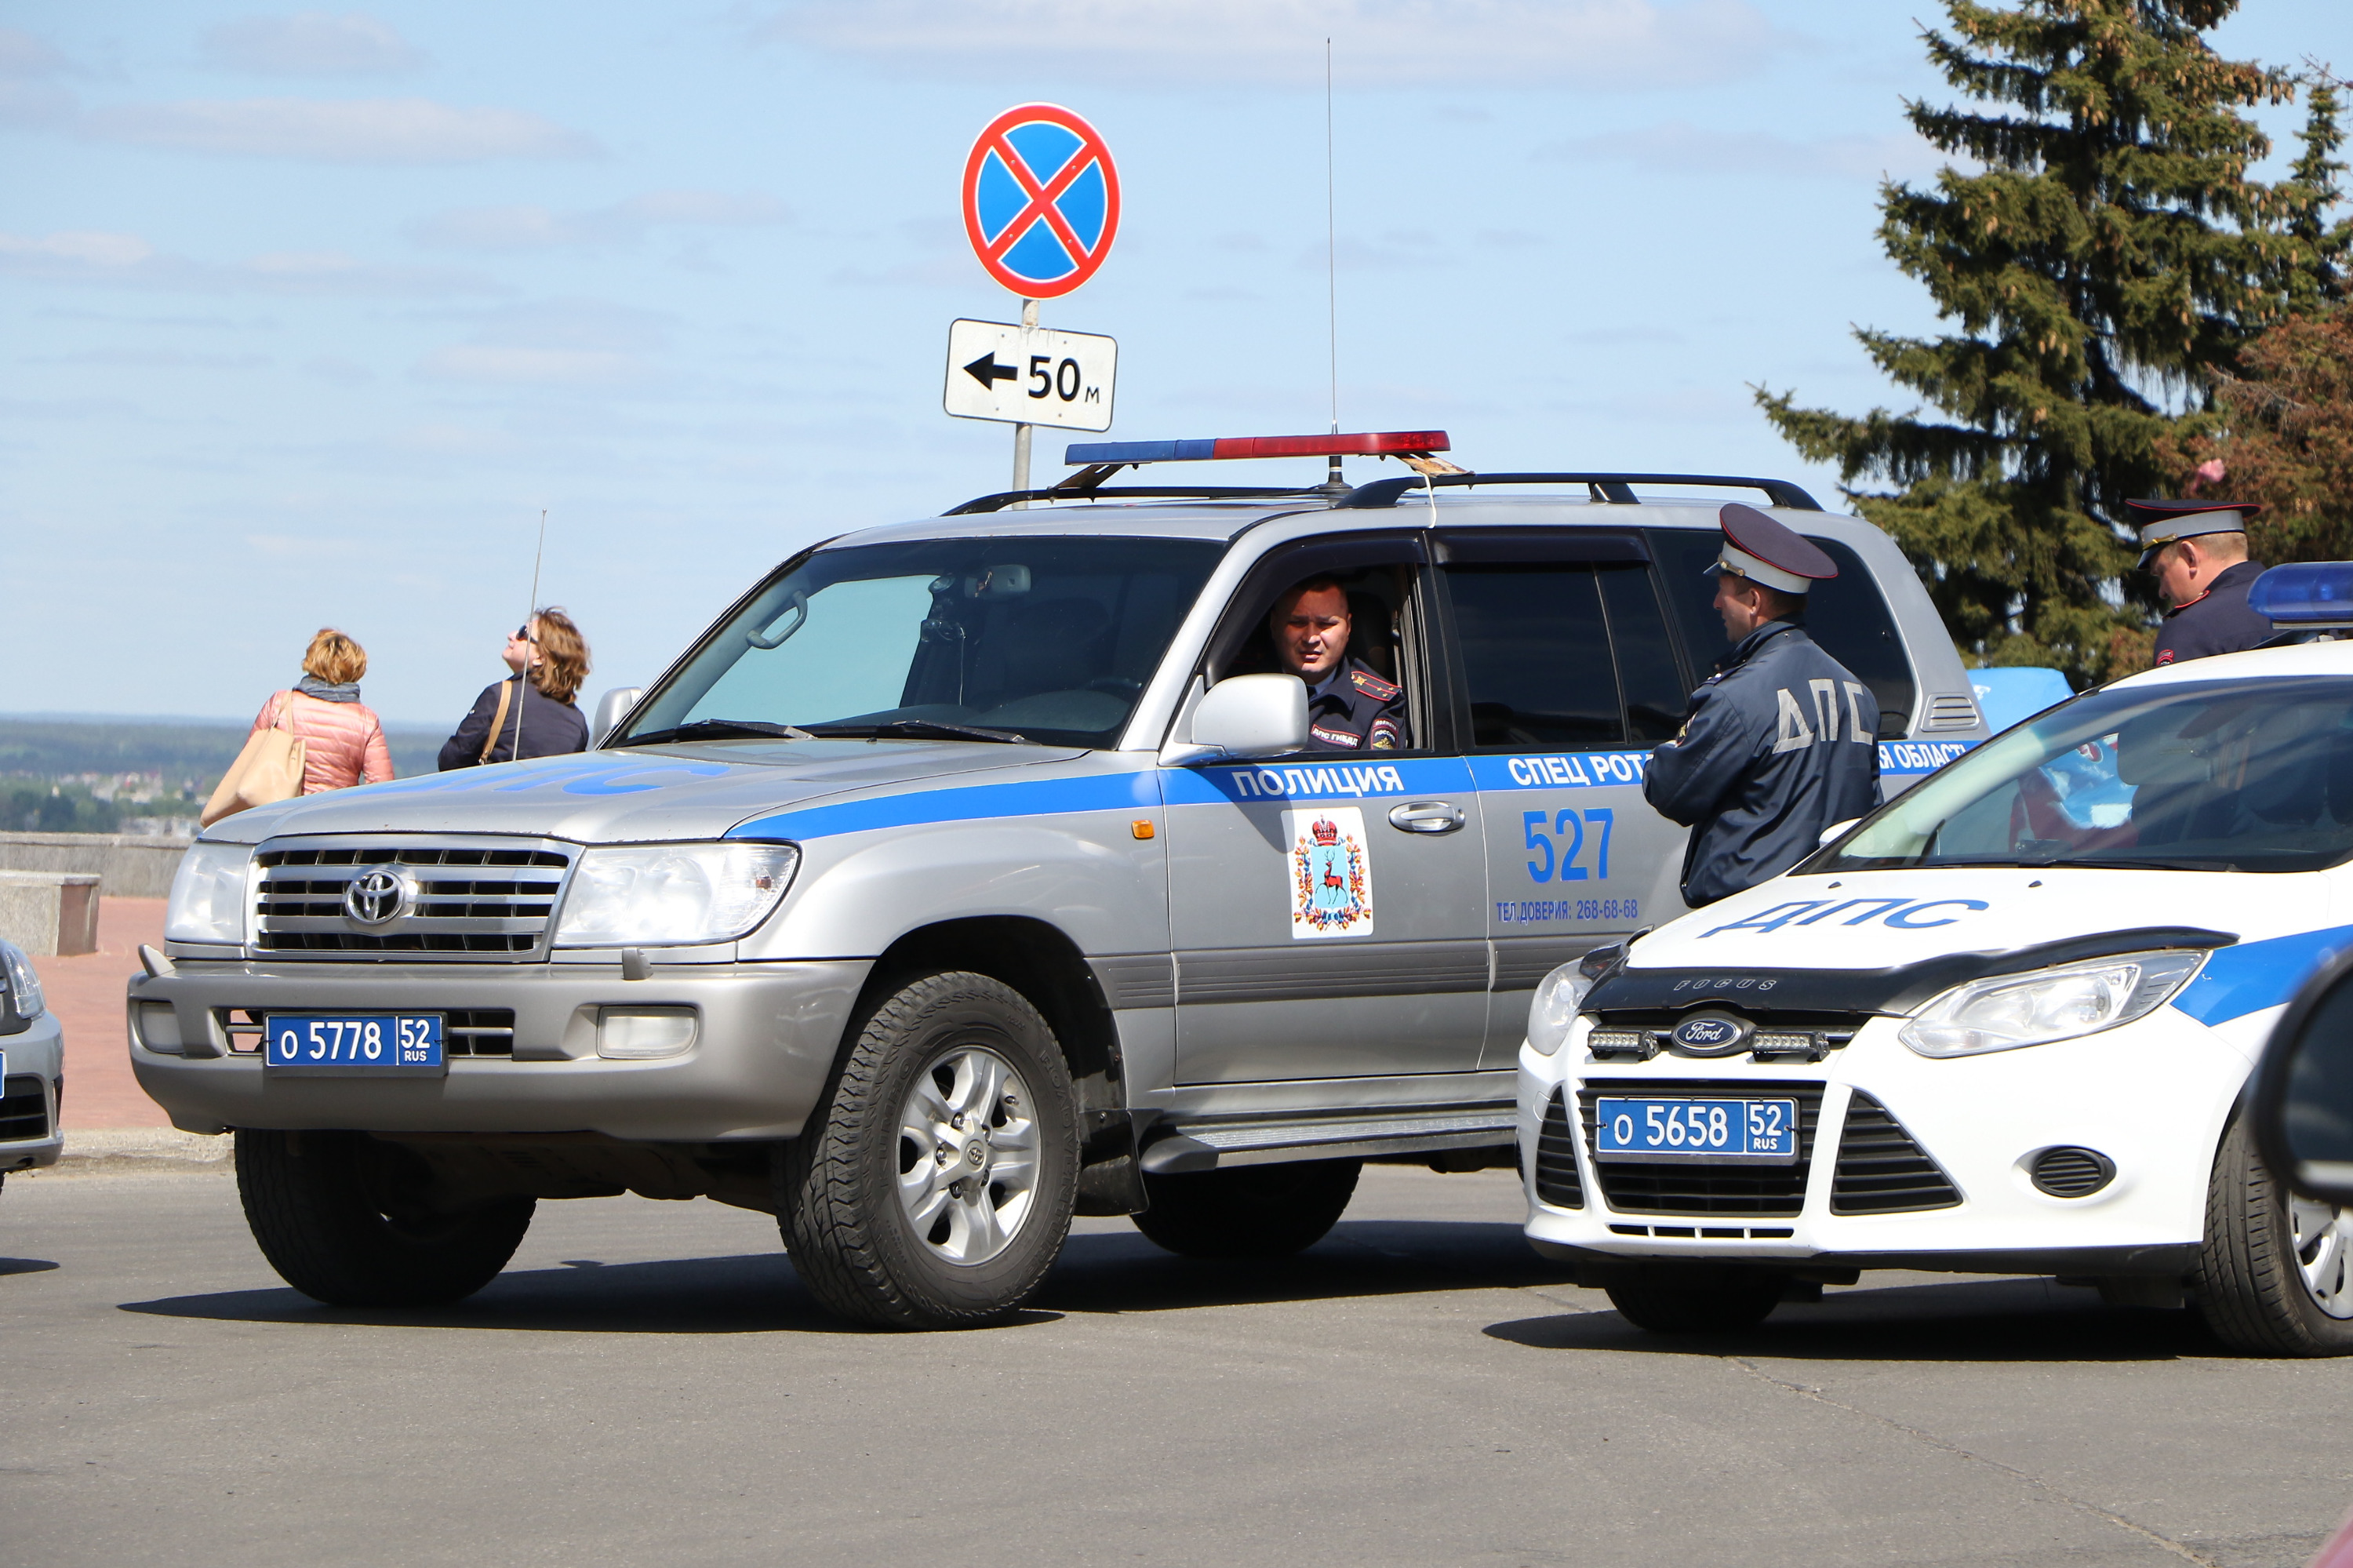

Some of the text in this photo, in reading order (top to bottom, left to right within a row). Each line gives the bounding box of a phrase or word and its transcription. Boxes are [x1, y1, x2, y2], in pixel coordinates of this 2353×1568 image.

[1772, 678, 1874, 754] ДПС
[1312, 727, 1358, 747] ДПС ГИБДД
[1231, 766, 1405, 797] ПОЛИЦИЯ
[1507, 753, 1654, 786] СПЕЦ РОТ
[1522, 807, 1614, 883] 527
[1577, 899, 1638, 920] 268-68-68
[1695, 897, 1990, 940] ДПС
[1674, 979, 1777, 991] FOCUS
[309, 1021, 383, 1060] 5778
[401, 1019, 431, 1049] 52
[1686, 1021, 1725, 1041] Ford
[404, 1050, 427, 1062] RUS
[1646, 1105, 1729, 1148] 5658
[1749, 1104, 1783, 1137] 52
[1753, 1138, 1778, 1151] RUS
